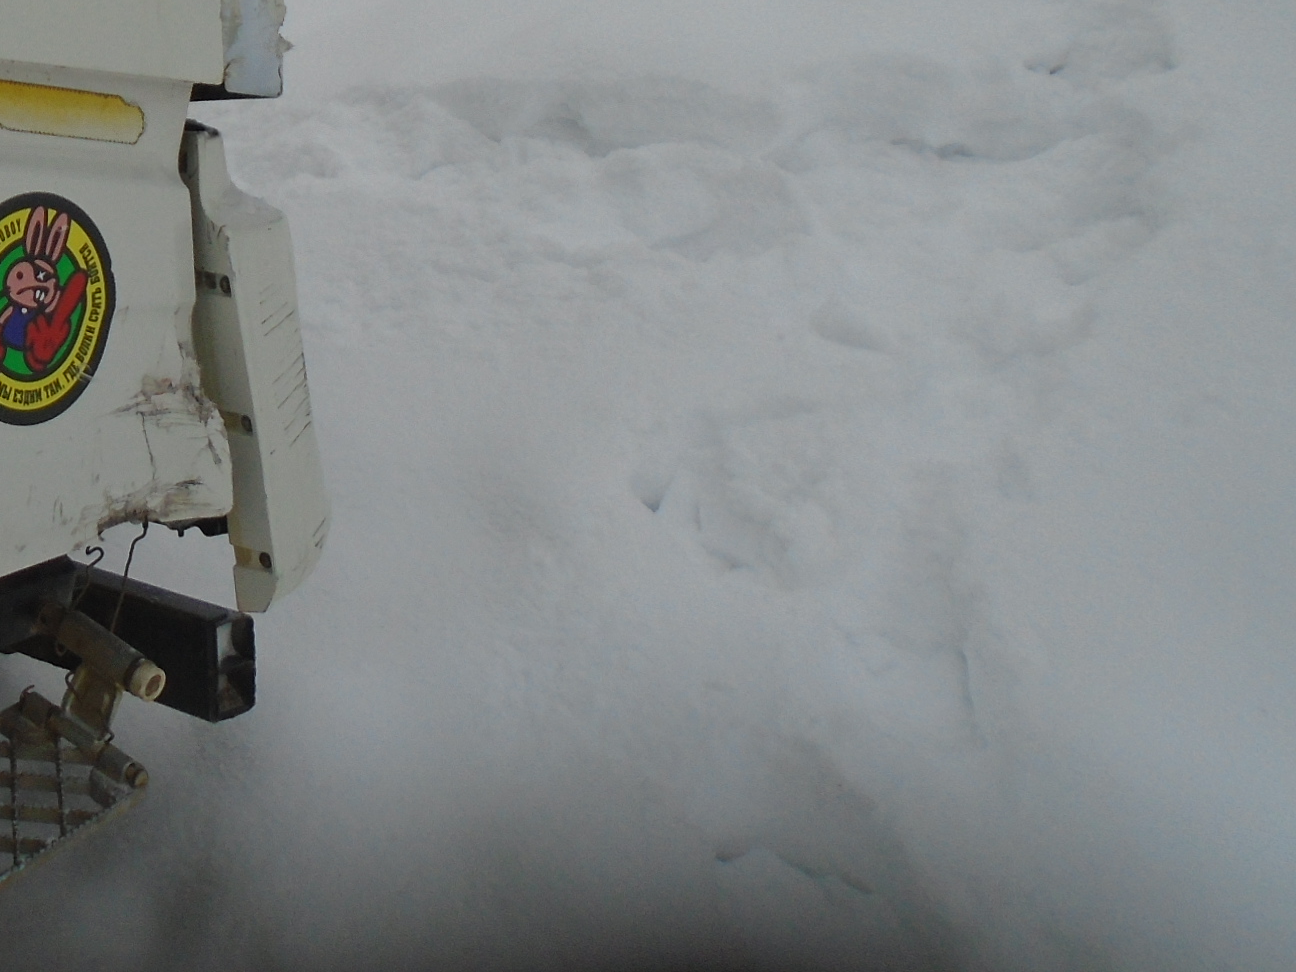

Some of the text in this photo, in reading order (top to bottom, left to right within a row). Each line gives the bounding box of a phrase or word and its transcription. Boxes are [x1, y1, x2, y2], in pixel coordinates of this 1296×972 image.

[79, 242, 101, 286] БОЯТСЯ
[88, 287, 103, 323] СРАТЬ
[75, 325, 96, 363] ВОЛКИ
[62, 360, 81, 384] ГДЕ
[12, 387, 43, 407] ЕЗДИМ
